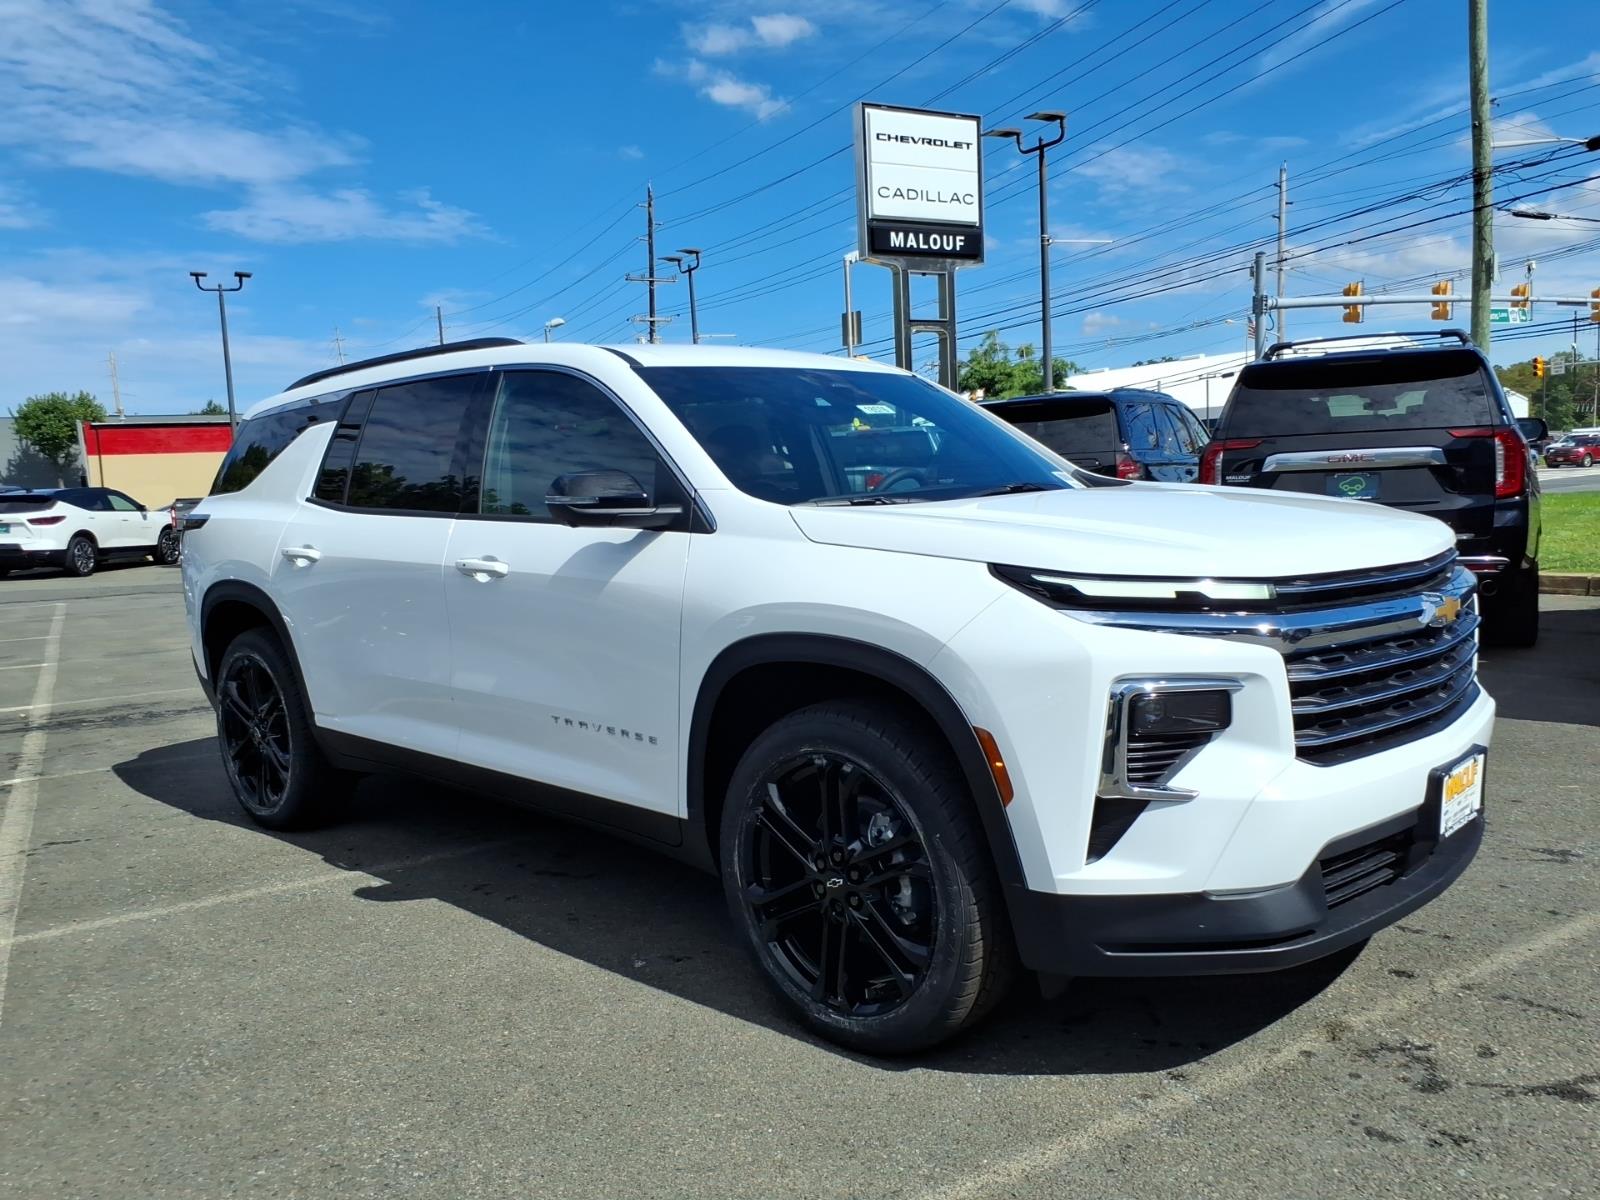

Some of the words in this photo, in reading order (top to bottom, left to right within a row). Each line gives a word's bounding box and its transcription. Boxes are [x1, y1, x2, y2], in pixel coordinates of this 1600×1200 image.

[876, 132, 973, 150] CHEVROLET
[877, 186, 975, 205] CADILLAC
[890, 231, 965, 251] MALOUF
[1327, 453, 1376, 463] GMC
[551, 714, 658, 746] TRAVERSE
